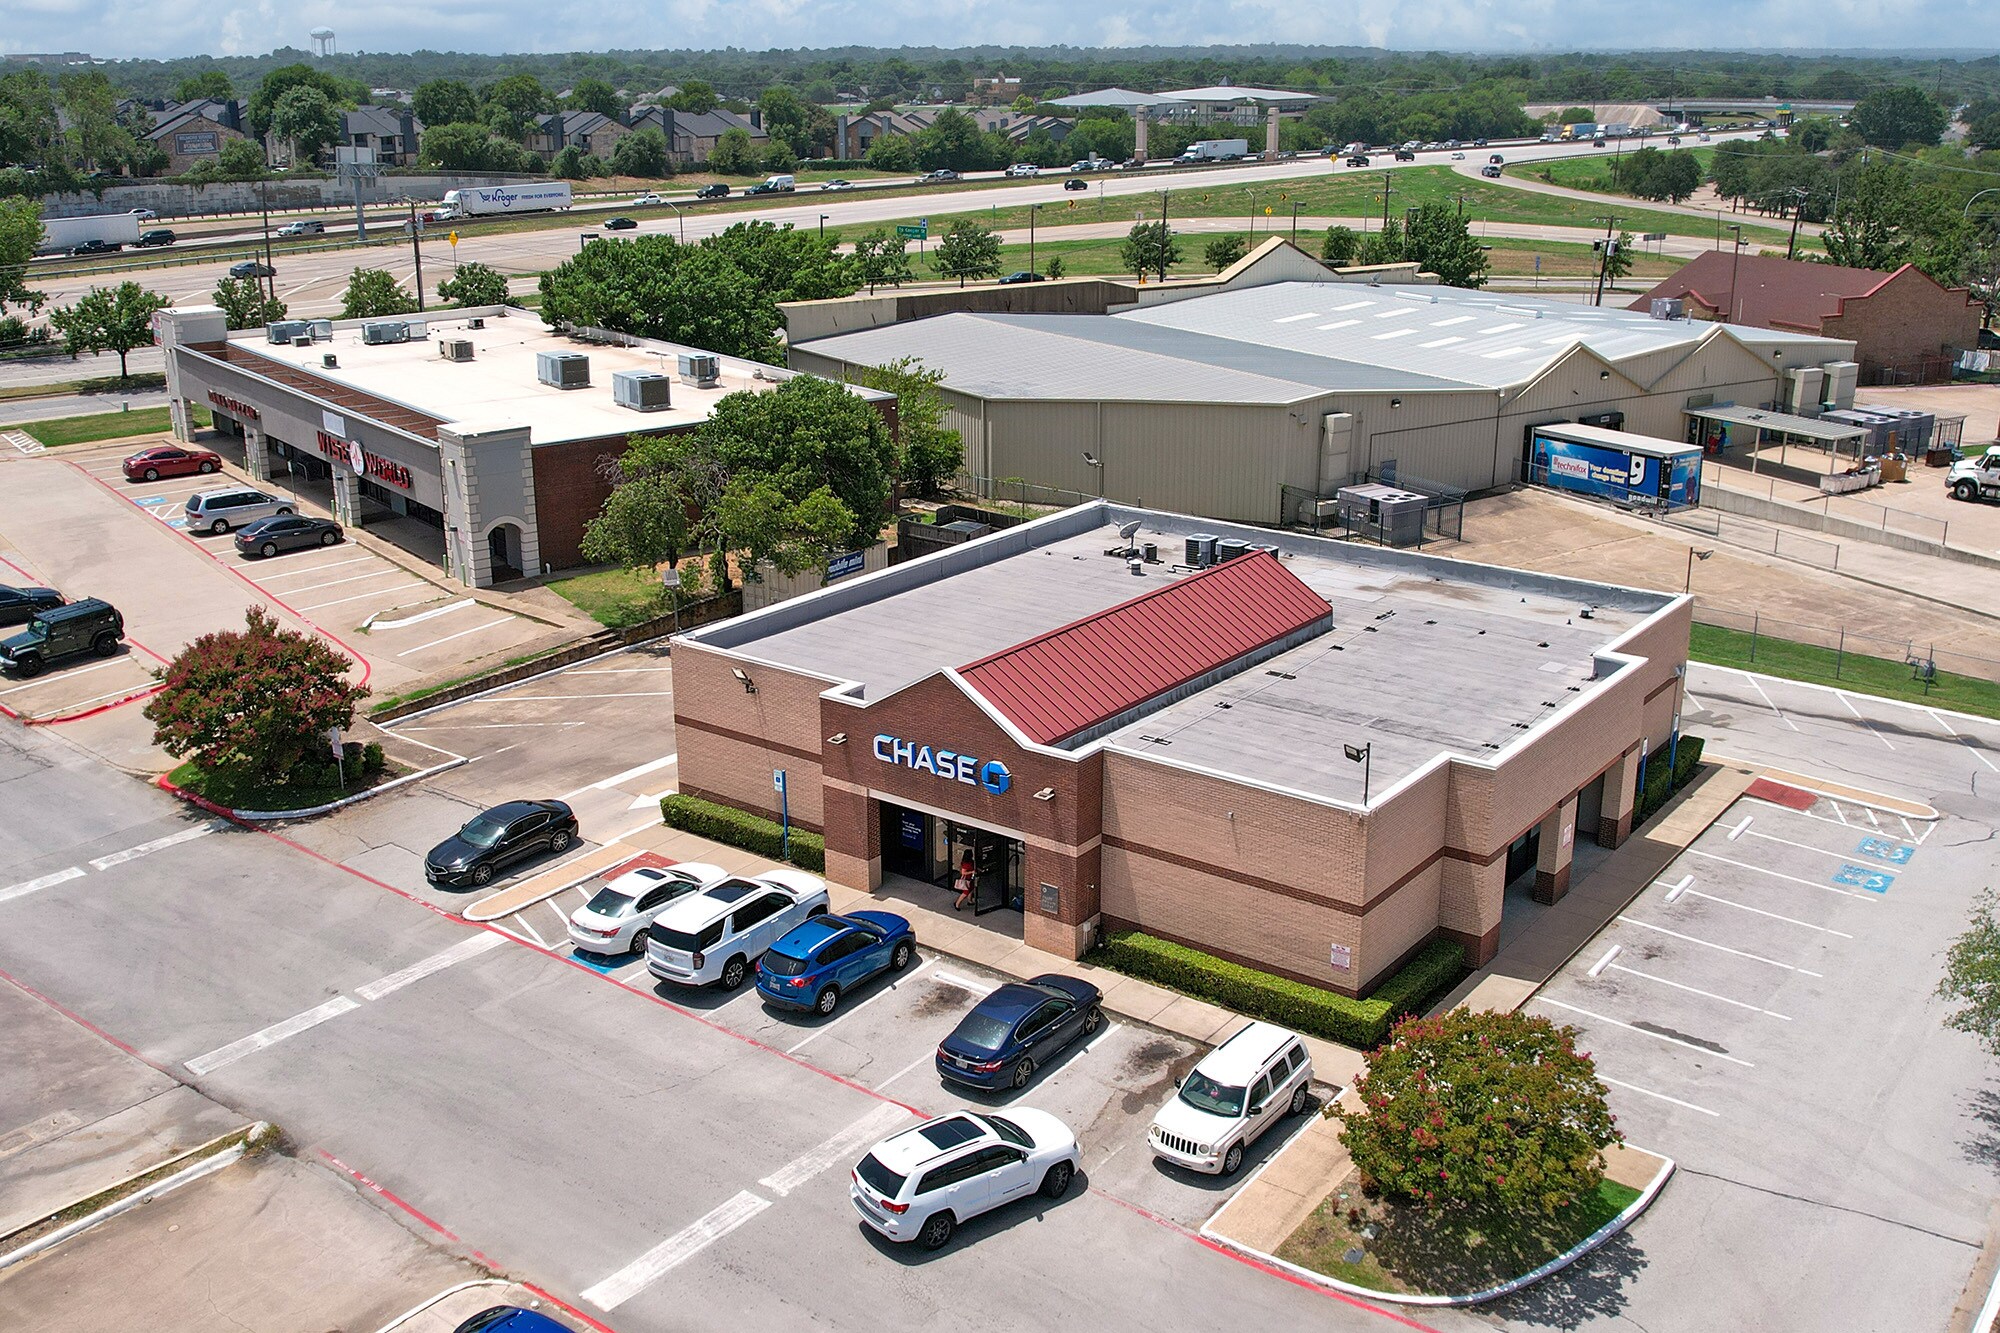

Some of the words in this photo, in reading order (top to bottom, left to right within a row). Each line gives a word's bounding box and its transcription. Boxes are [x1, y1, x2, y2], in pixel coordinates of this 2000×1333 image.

[492, 188, 518, 208] Kroger
[317, 430, 352, 466] WISE
[364, 451, 411, 490] WORLD
[873, 733, 979, 786] CHASE
